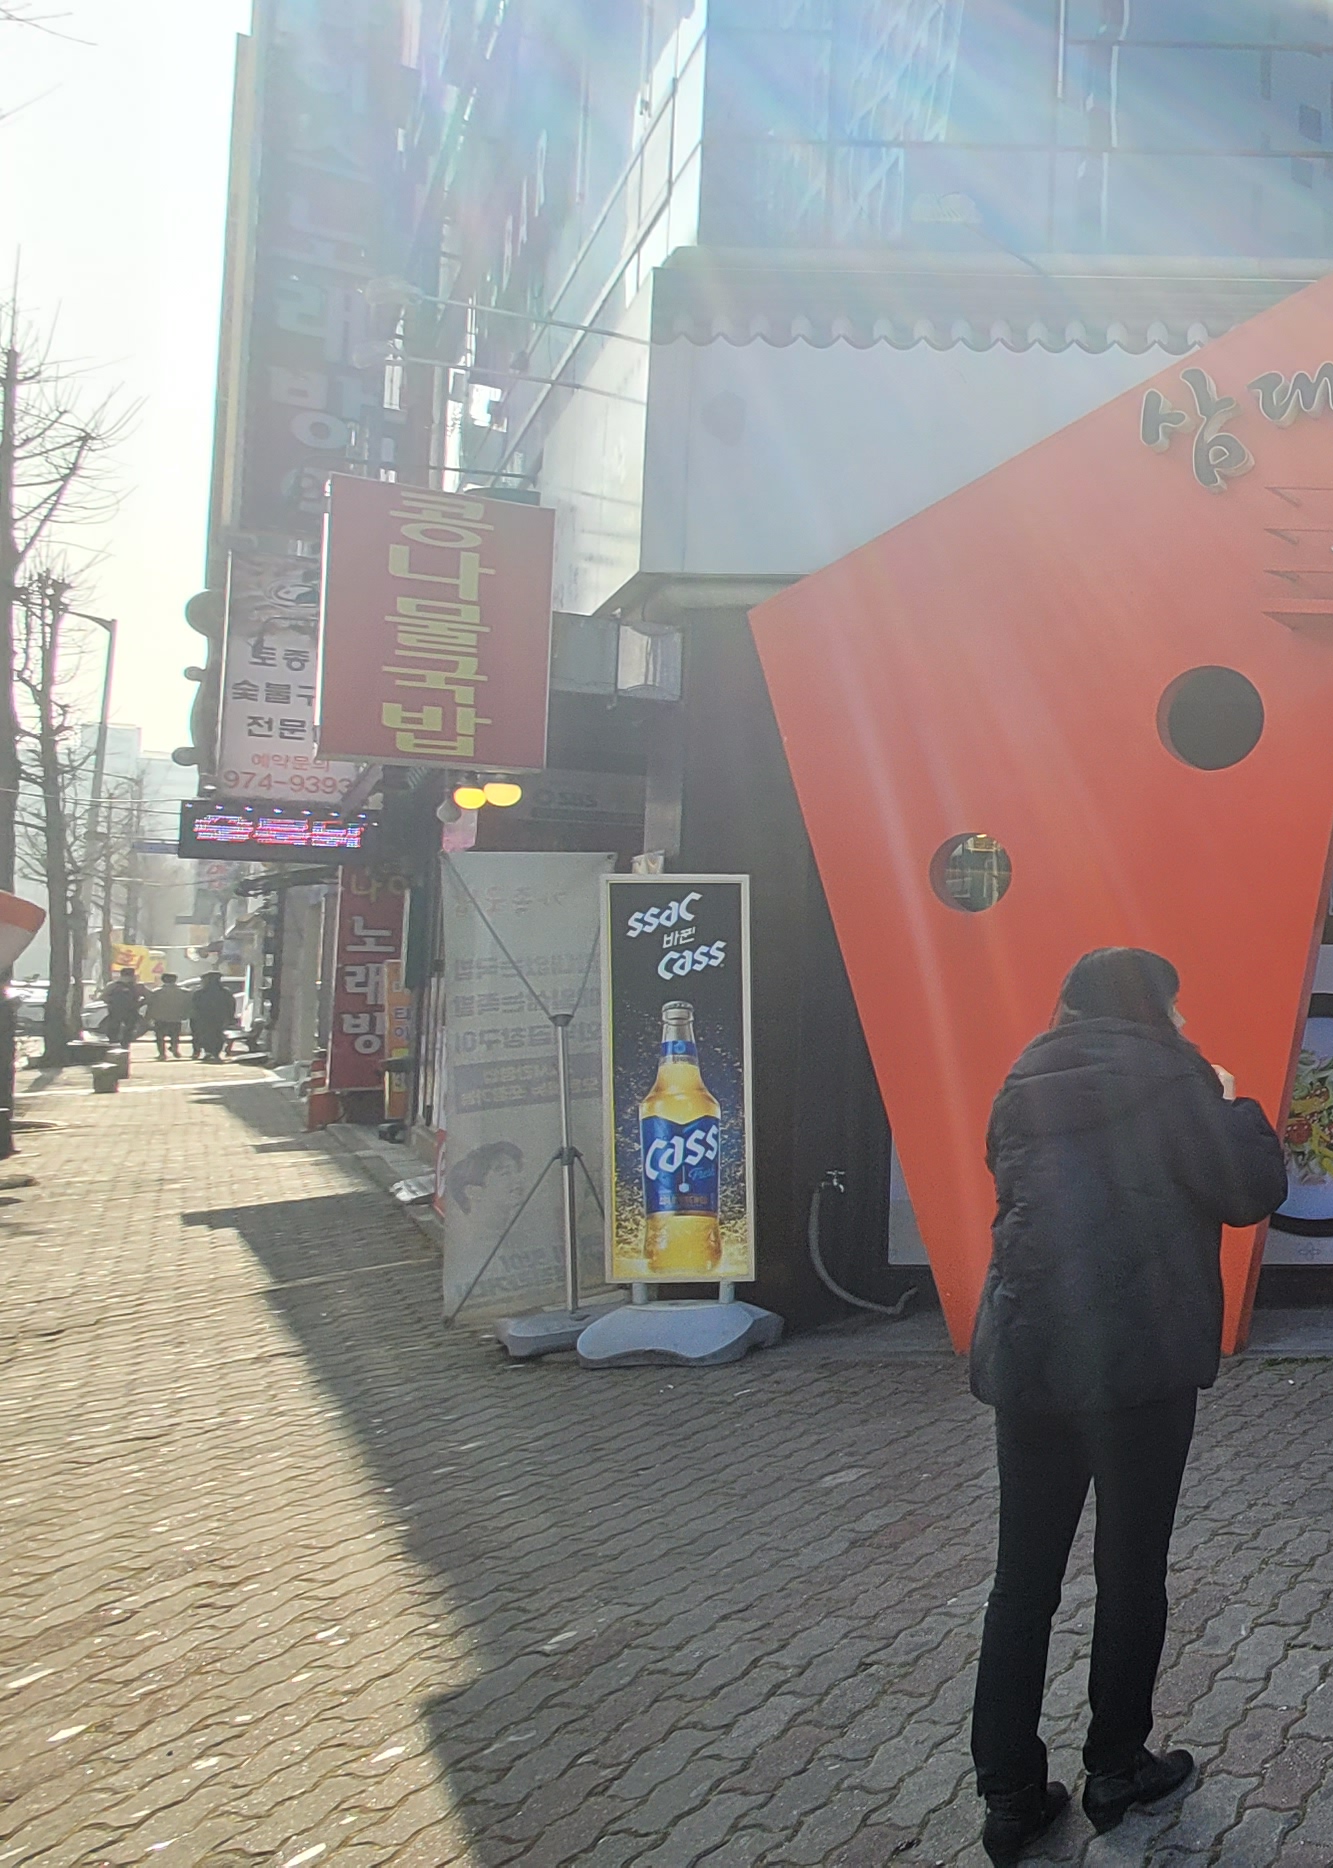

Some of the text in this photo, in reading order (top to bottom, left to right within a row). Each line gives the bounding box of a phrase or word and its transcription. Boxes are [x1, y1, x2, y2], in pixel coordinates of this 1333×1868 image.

[382, 489, 495, 758] 콩나물국밥
[249, 646, 310, 673] 토종
[231, 678, 316, 706] 숯불구
[247, 715, 314, 741] 전문
[251, 752, 330, 773] 예약문의
[223, 769, 352, 796] 974-9393
